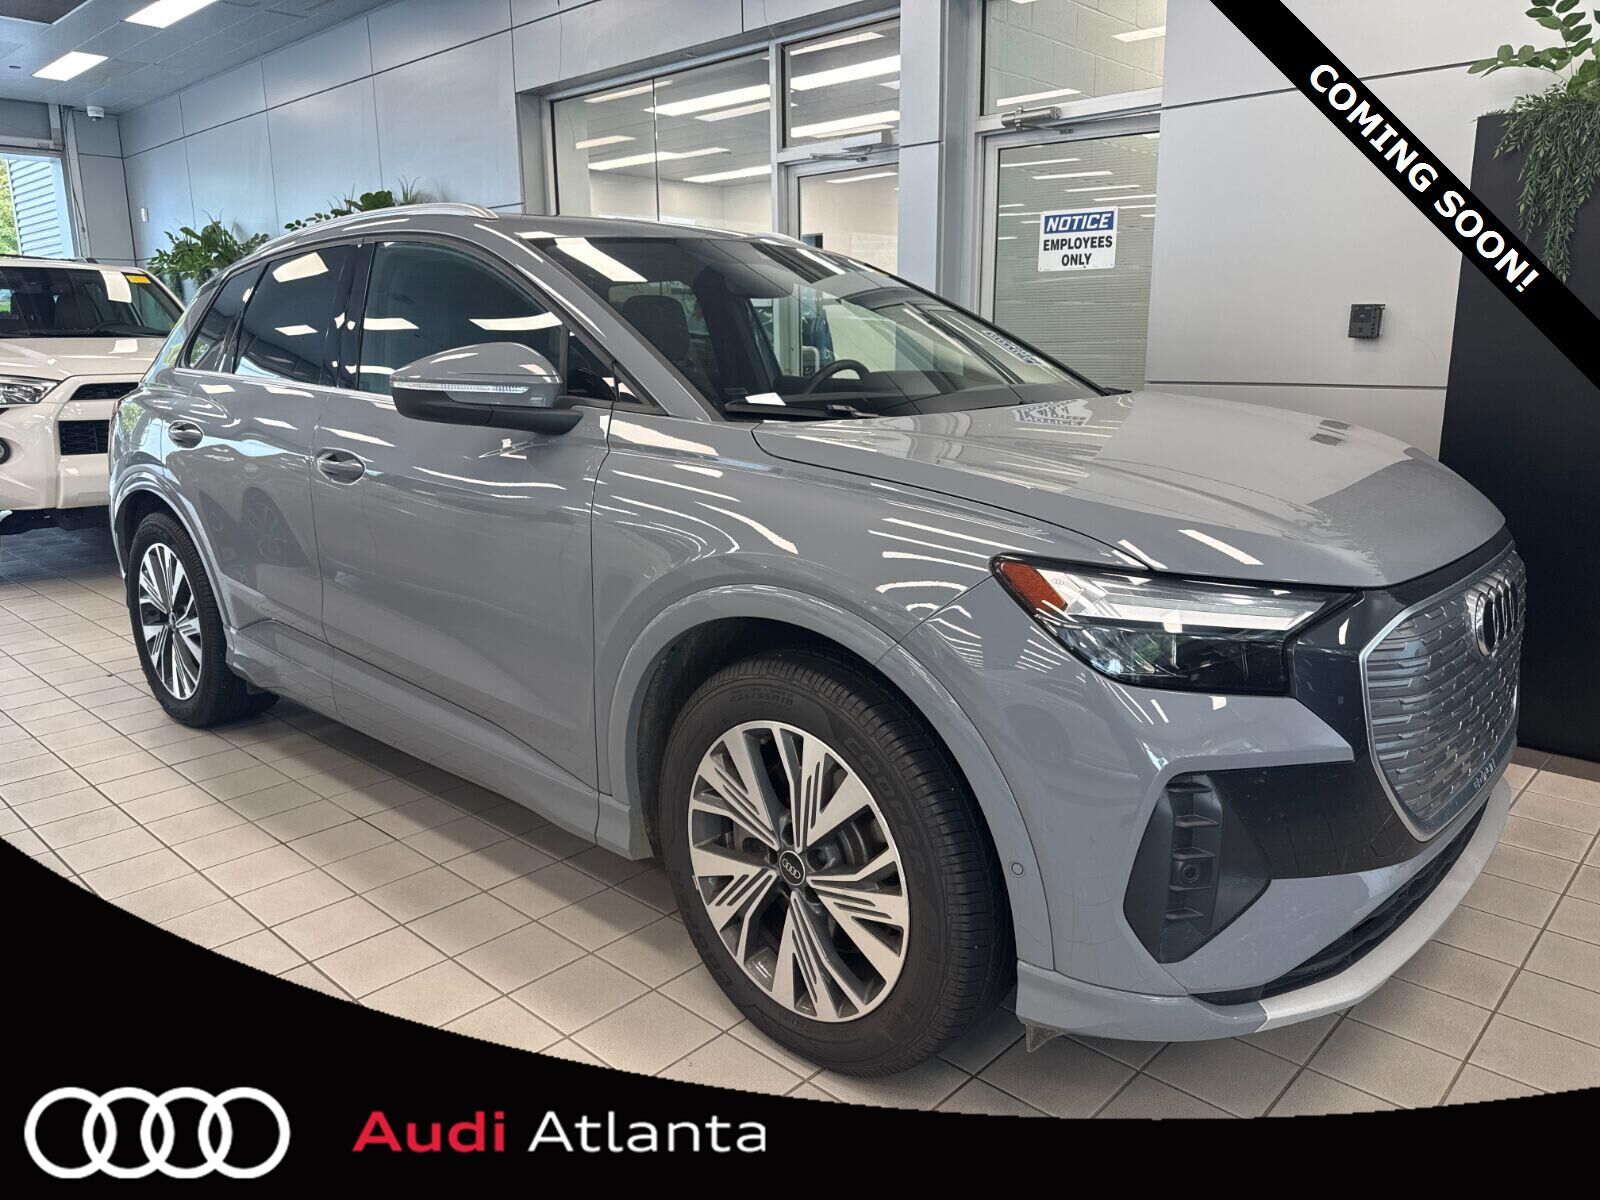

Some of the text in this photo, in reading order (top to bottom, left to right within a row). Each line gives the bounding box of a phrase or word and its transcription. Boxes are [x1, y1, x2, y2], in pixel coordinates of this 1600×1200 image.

[1046, 213, 1112, 232] NOTICE
[1043, 235, 1113, 251] EMPLOYEES
[1061, 253, 1092, 266] ONLY
